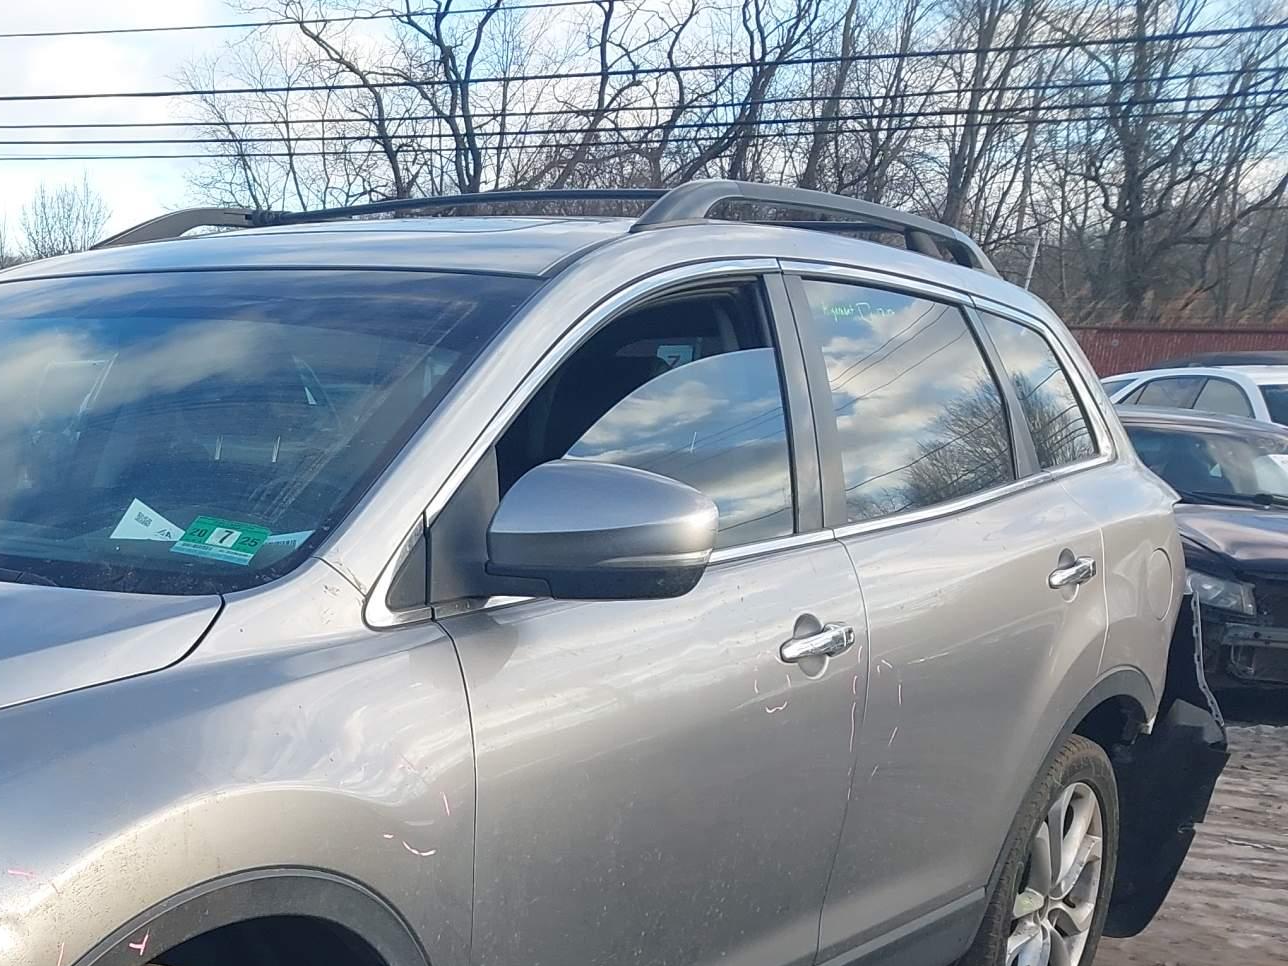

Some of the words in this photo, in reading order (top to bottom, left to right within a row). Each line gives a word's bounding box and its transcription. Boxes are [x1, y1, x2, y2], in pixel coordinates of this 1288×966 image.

[189, 527, 209, 538] 20
[219, 529, 234, 543] 7
[239, 536, 261, 547] 25
